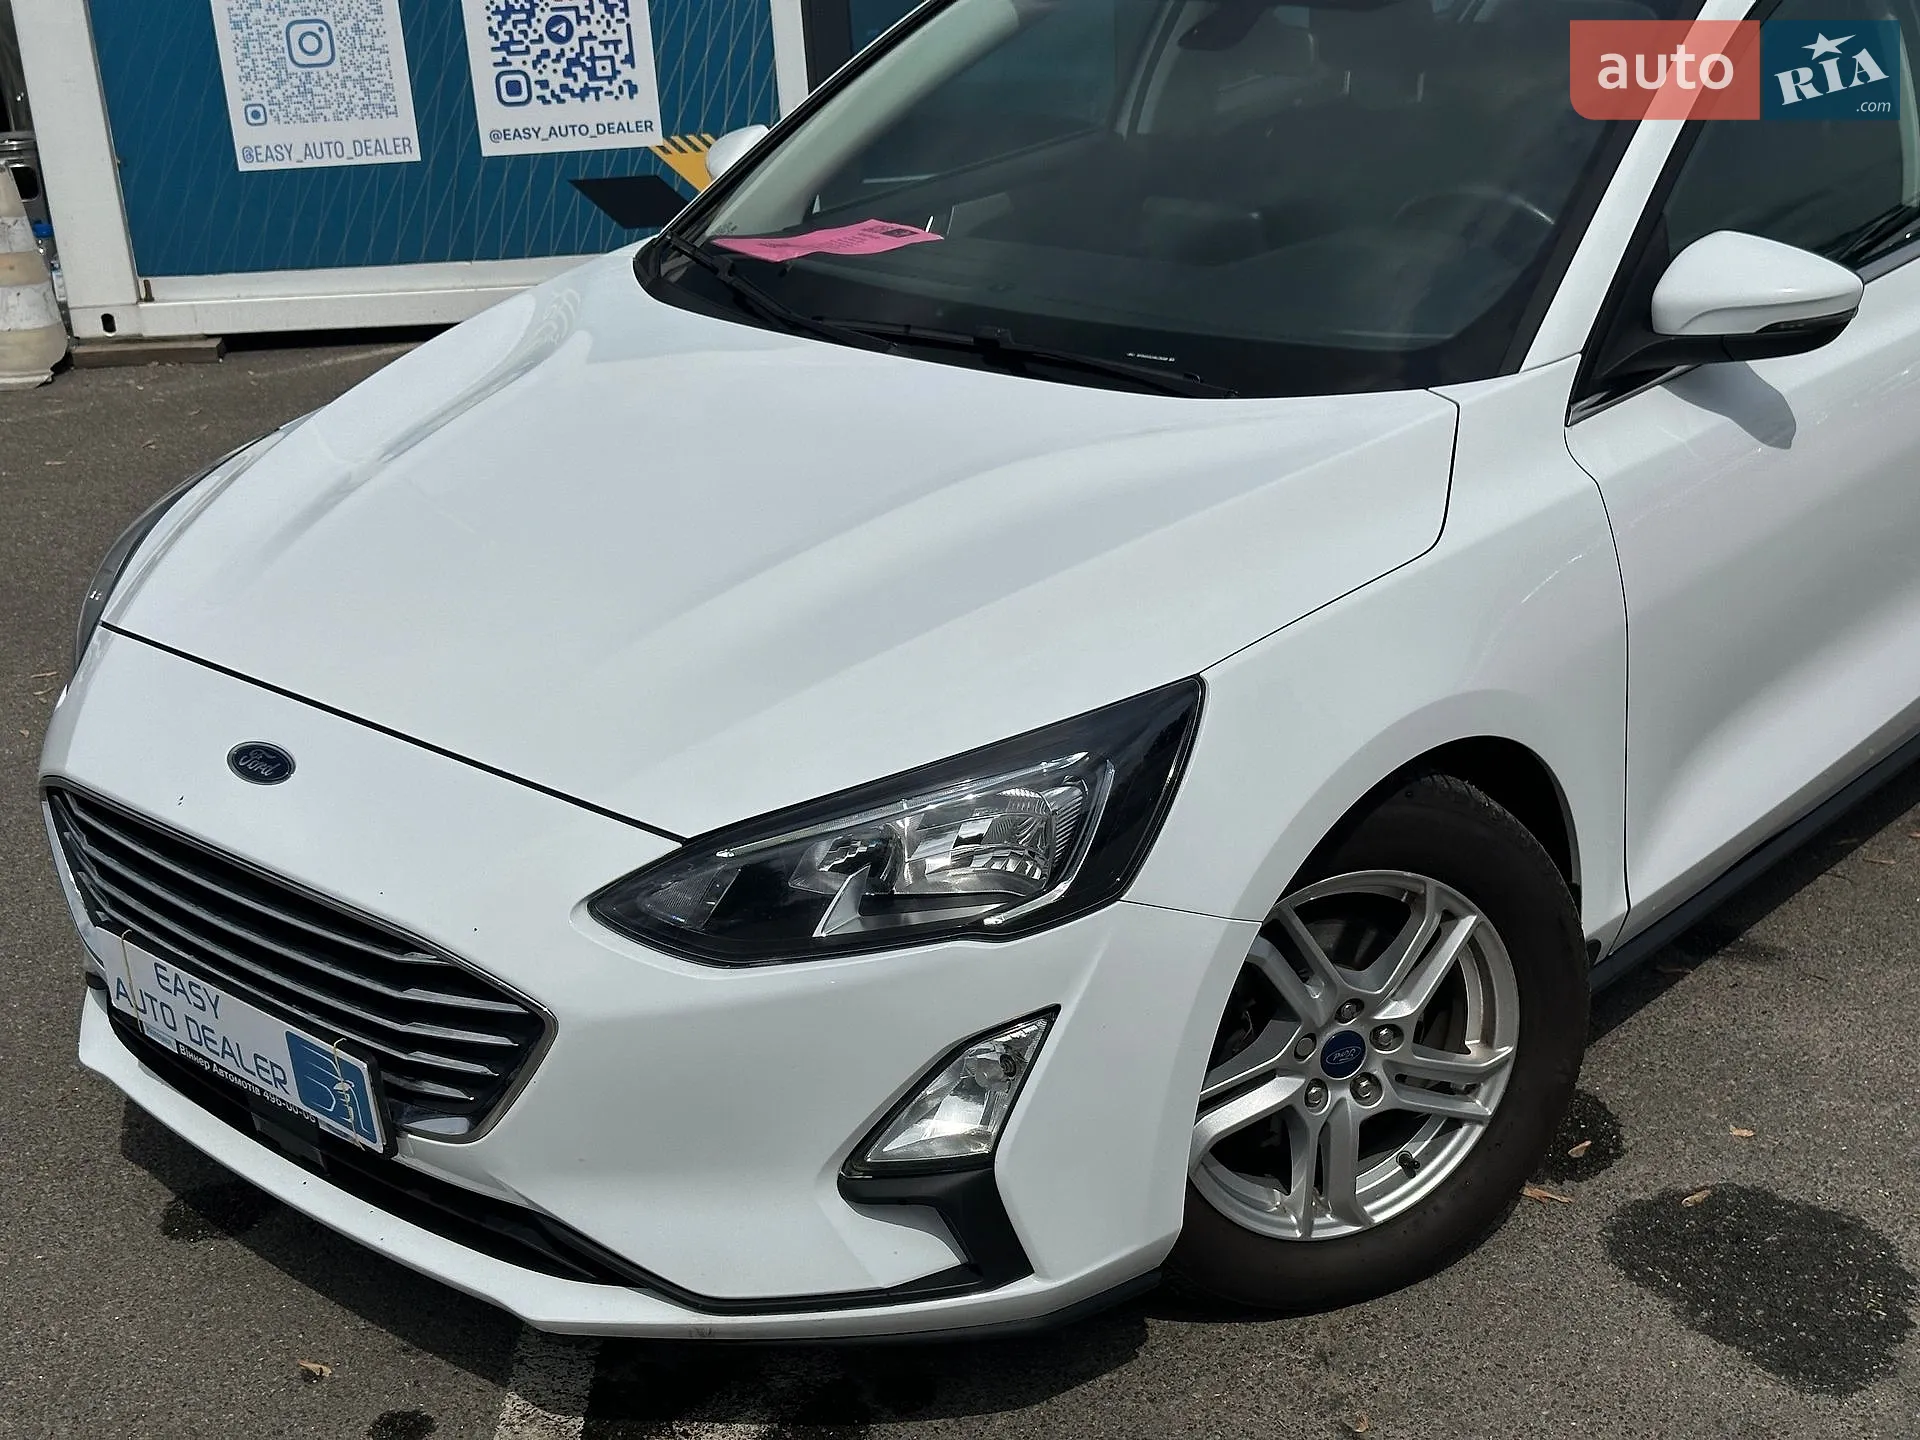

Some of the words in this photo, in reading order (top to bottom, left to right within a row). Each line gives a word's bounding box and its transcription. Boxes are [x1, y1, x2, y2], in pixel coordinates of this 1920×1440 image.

[488, 119, 654, 143] @EASY_AUTO_DEALER
[241, 136, 413, 164] @EASY_AUTO_DEALER
[239, 748, 282, 777] Ford
[154, 962, 220, 1019] EASY
[115, 976, 176, 1033] AUTO
[186, 1015, 289, 1094] DEALER
